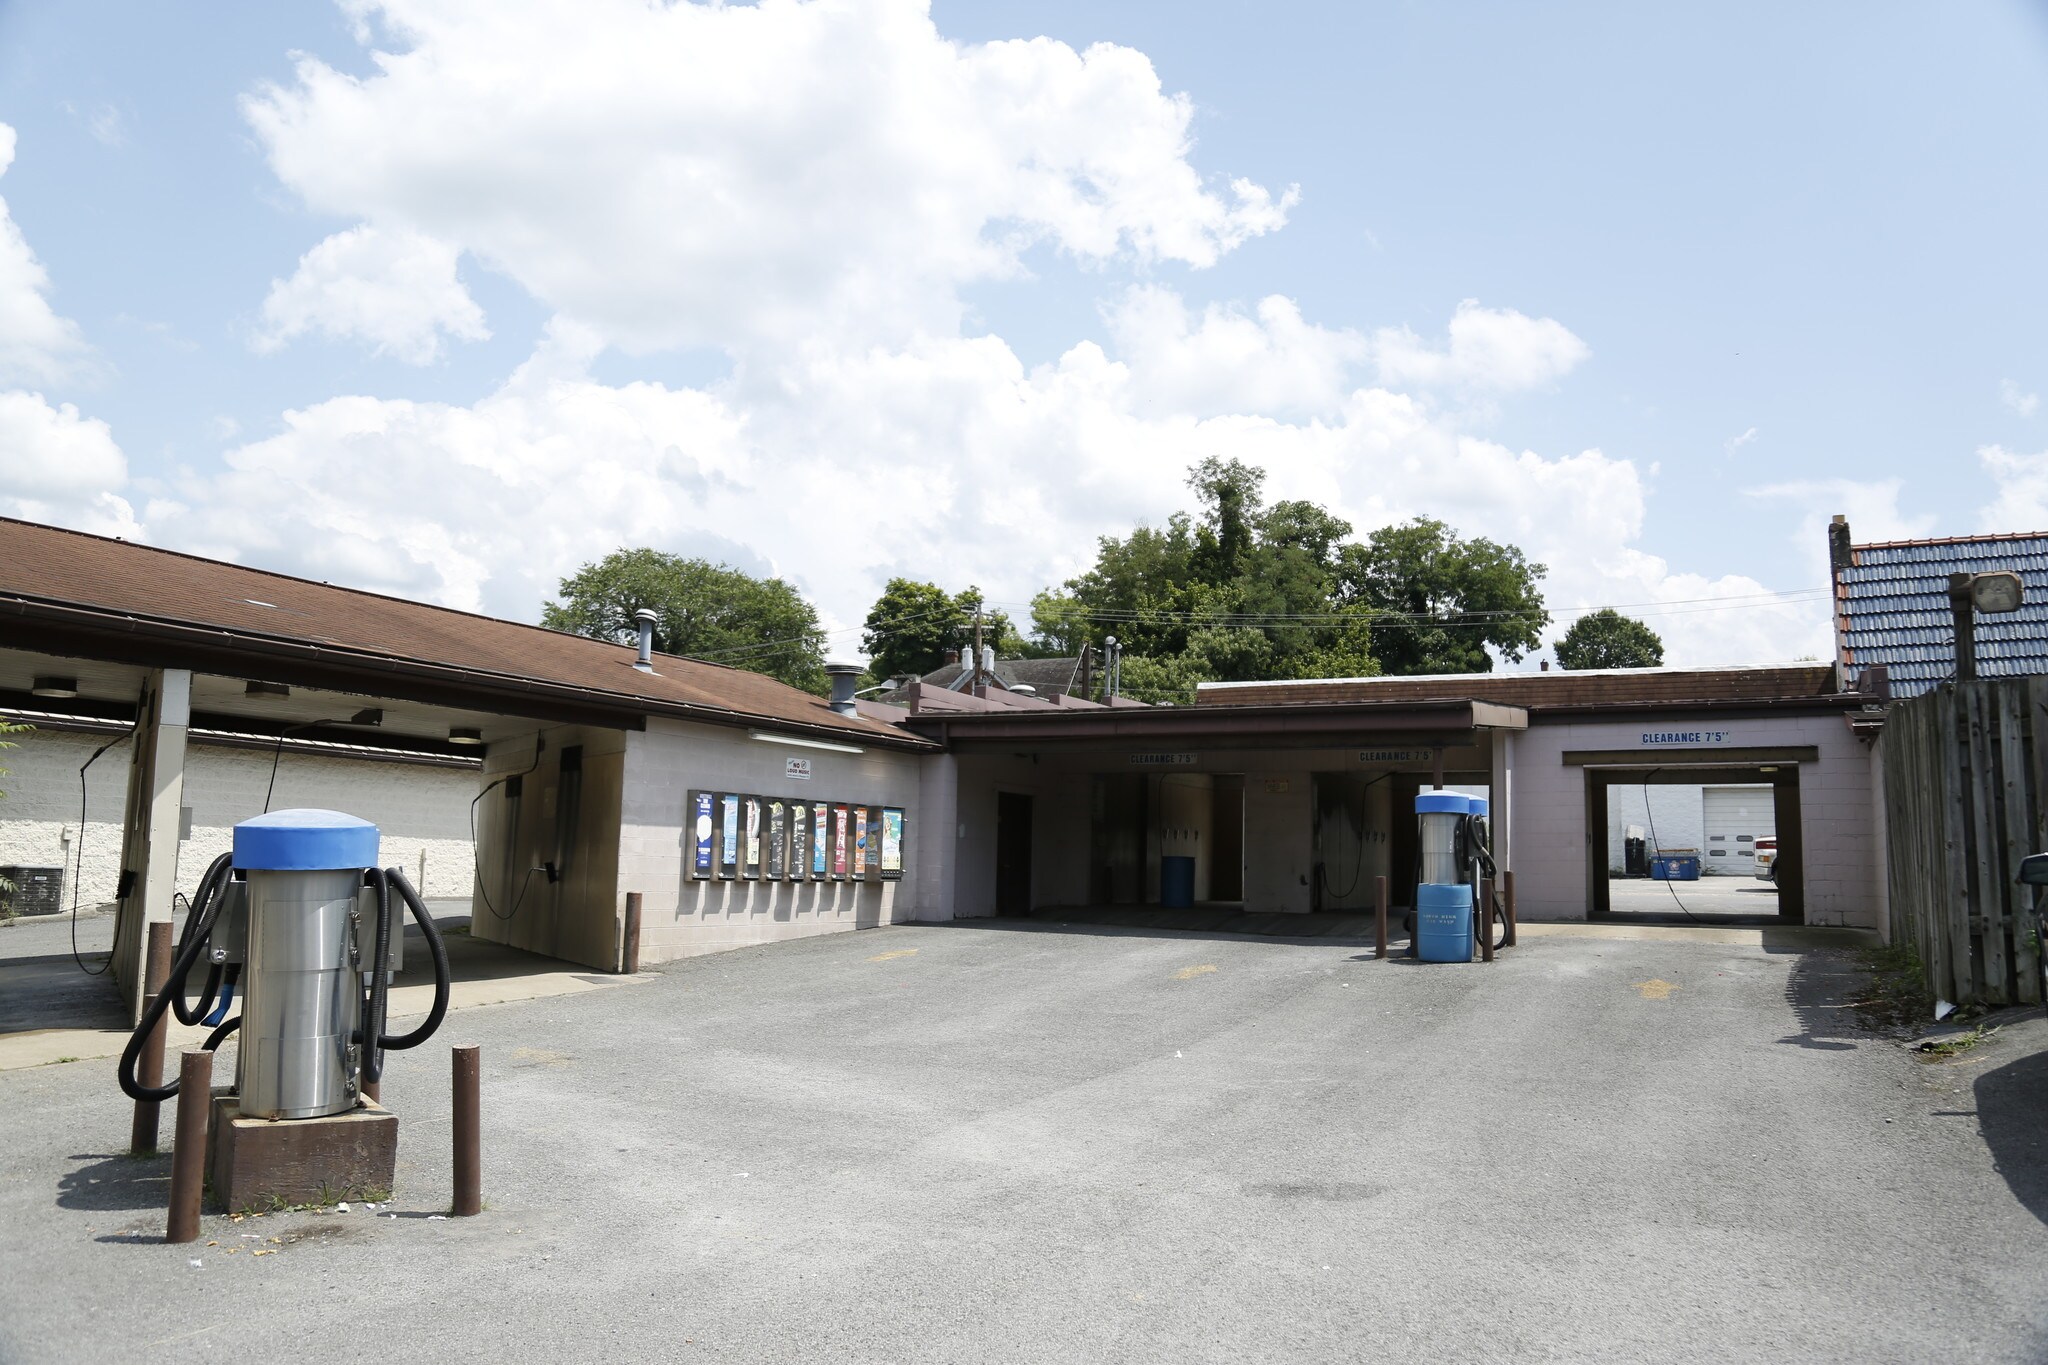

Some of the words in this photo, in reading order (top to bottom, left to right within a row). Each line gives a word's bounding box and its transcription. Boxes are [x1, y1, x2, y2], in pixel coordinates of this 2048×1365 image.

[1642, 732, 1701, 743] CLEARANCE
[1131, 755, 1175, 763] CLEARANCE
[1360, 751, 1410, 761] CLEARANCE
